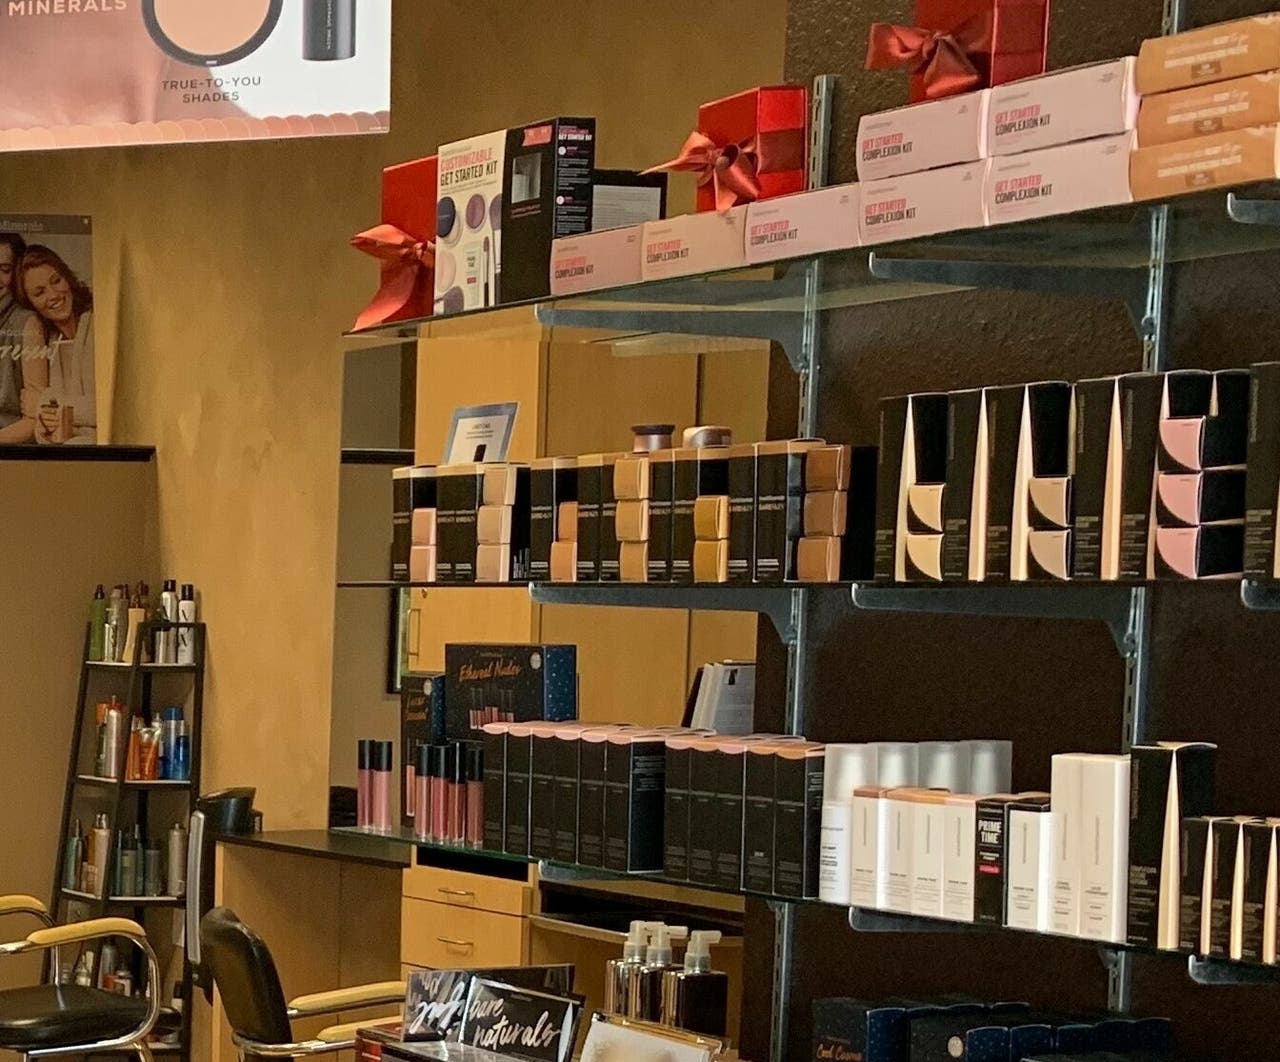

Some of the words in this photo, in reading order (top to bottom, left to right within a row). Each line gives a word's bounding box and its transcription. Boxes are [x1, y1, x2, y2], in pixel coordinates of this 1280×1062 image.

[8, 0, 128, 17] MINERALS
[161, 76, 262, 90] TRUE-TO-YOU
[181, 91, 240, 104] SHADES
[995, 118, 1038, 136] COMPLEXION
[1039, 114, 1051, 127] KIT
[441, 148, 493, 172] CUSTOMIZABLE
[862, 144, 902, 161] COMPLEXION
[903, 142, 913, 153] KIT
[440, 171, 454, 186] GET
[455, 165, 484, 183] STARTED
[485, 160, 498, 174] KIT
[995, 188, 1040, 204] COMPLEXION
[1041, 184, 1052, 196] KIT
[865, 209, 904, 226] COMPLEXION
[906, 207, 916, 219] KIT
[750, 231, 787, 246] COMPLEXION
[788, 228, 798, 240] KIT
[679, 248, 689, 259] KIT
[978, 820, 1002, 834] PRIME
[980, 832, 1000, 844] TIME
